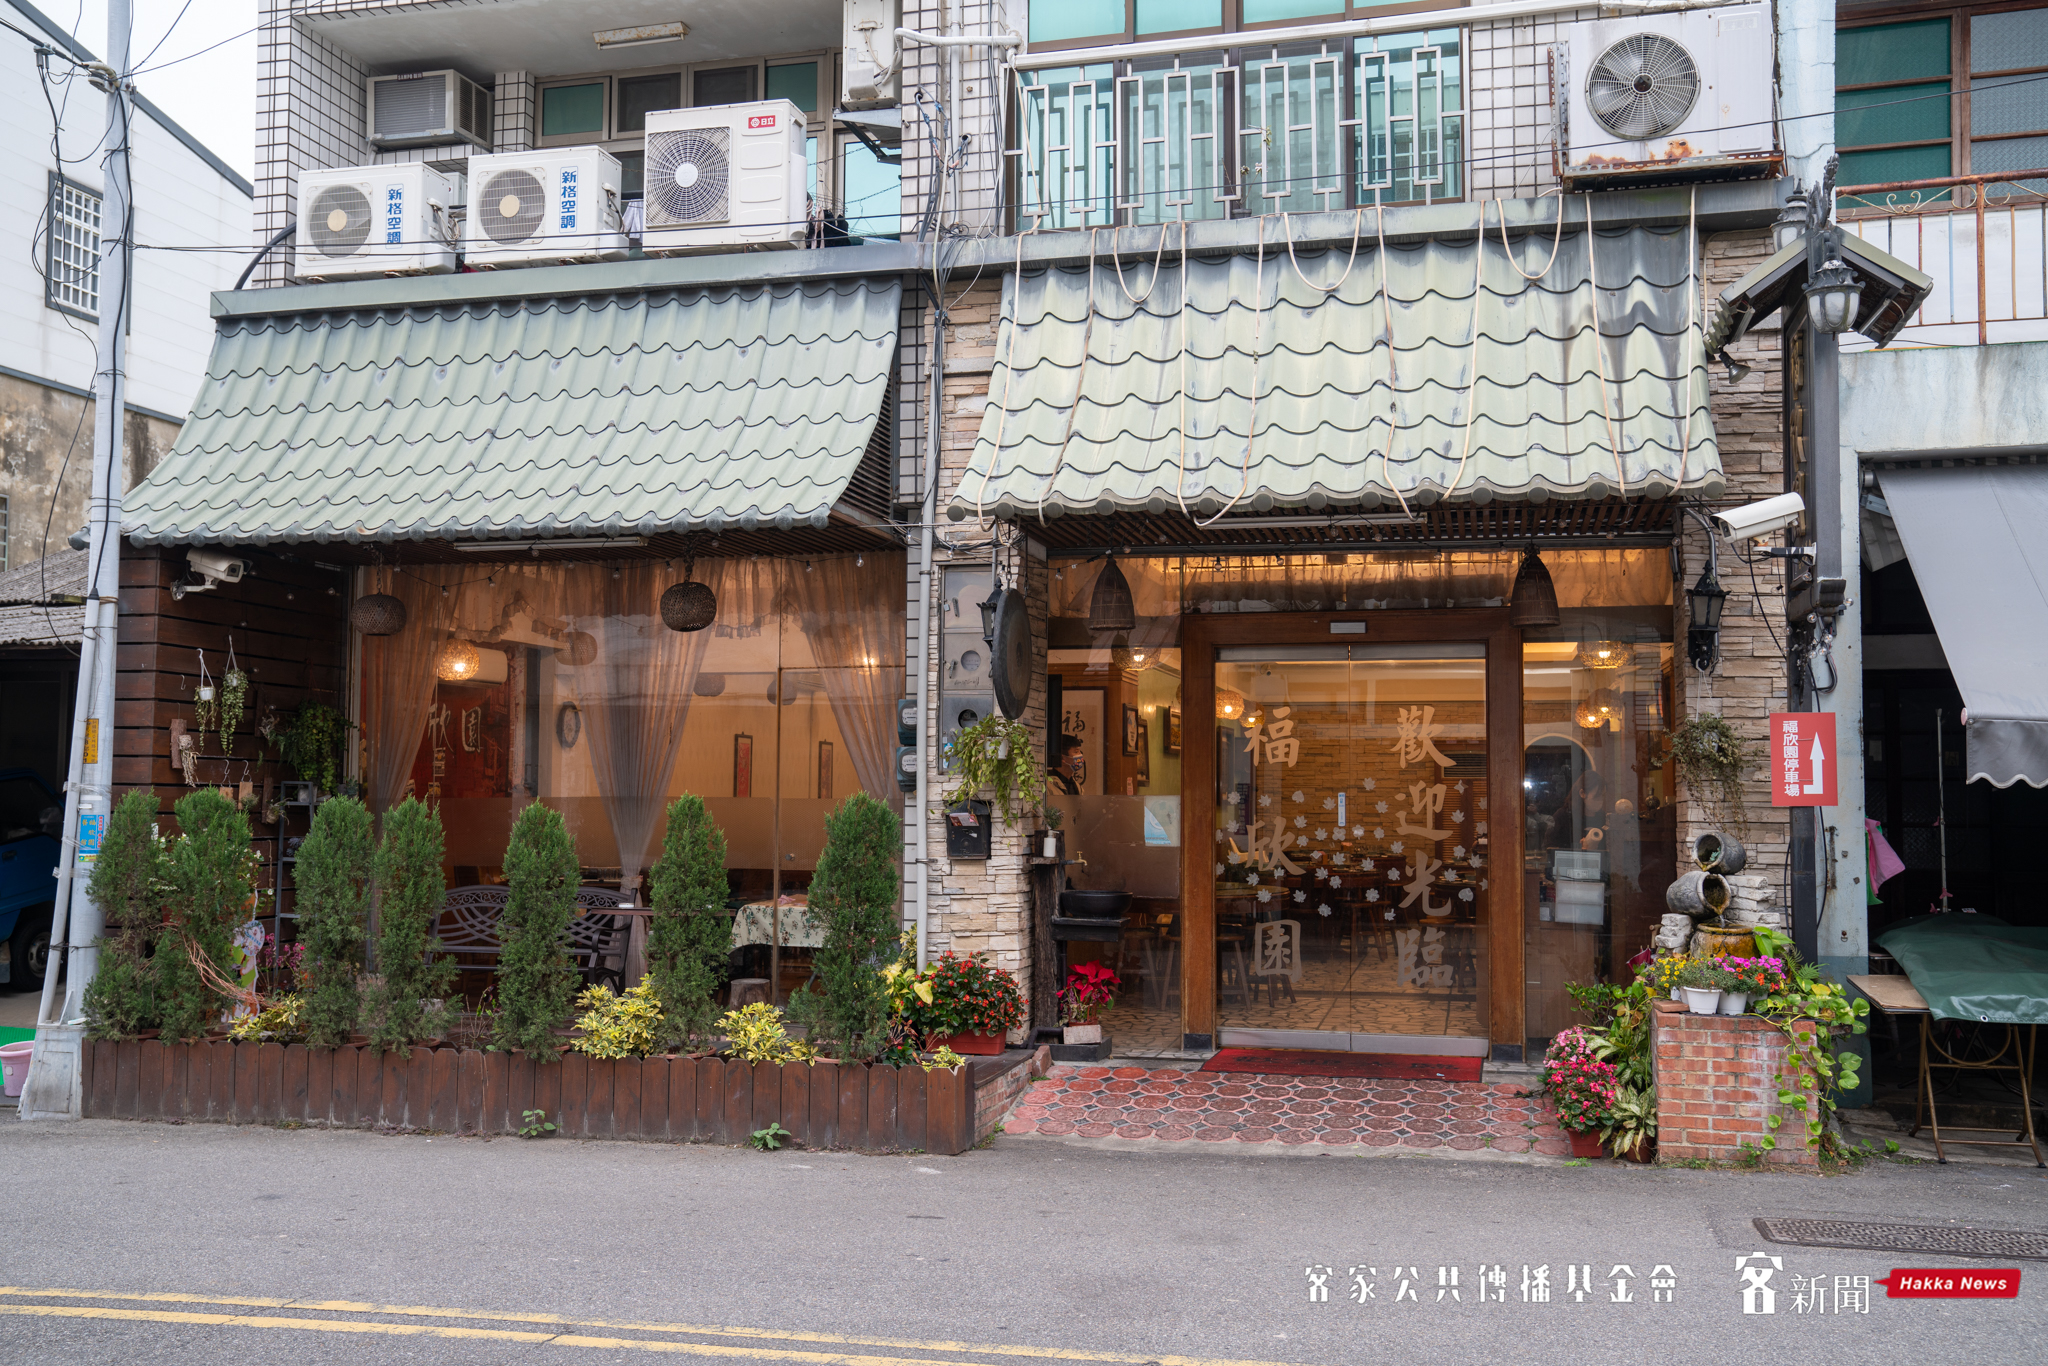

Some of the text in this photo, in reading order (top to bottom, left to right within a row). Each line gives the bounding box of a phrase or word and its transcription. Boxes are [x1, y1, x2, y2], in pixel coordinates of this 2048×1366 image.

[761, 117, 774, 125] 日立
[386, 188, 403, 245] 新格空調
[561, 171, 577, 229] 新格空調
[1782, 720, 1800, 797] 福欣園停車場
[1243, 706, 1306, 983] 福欣園
[1390, 705, 1457, 988] 歡迎光臨
